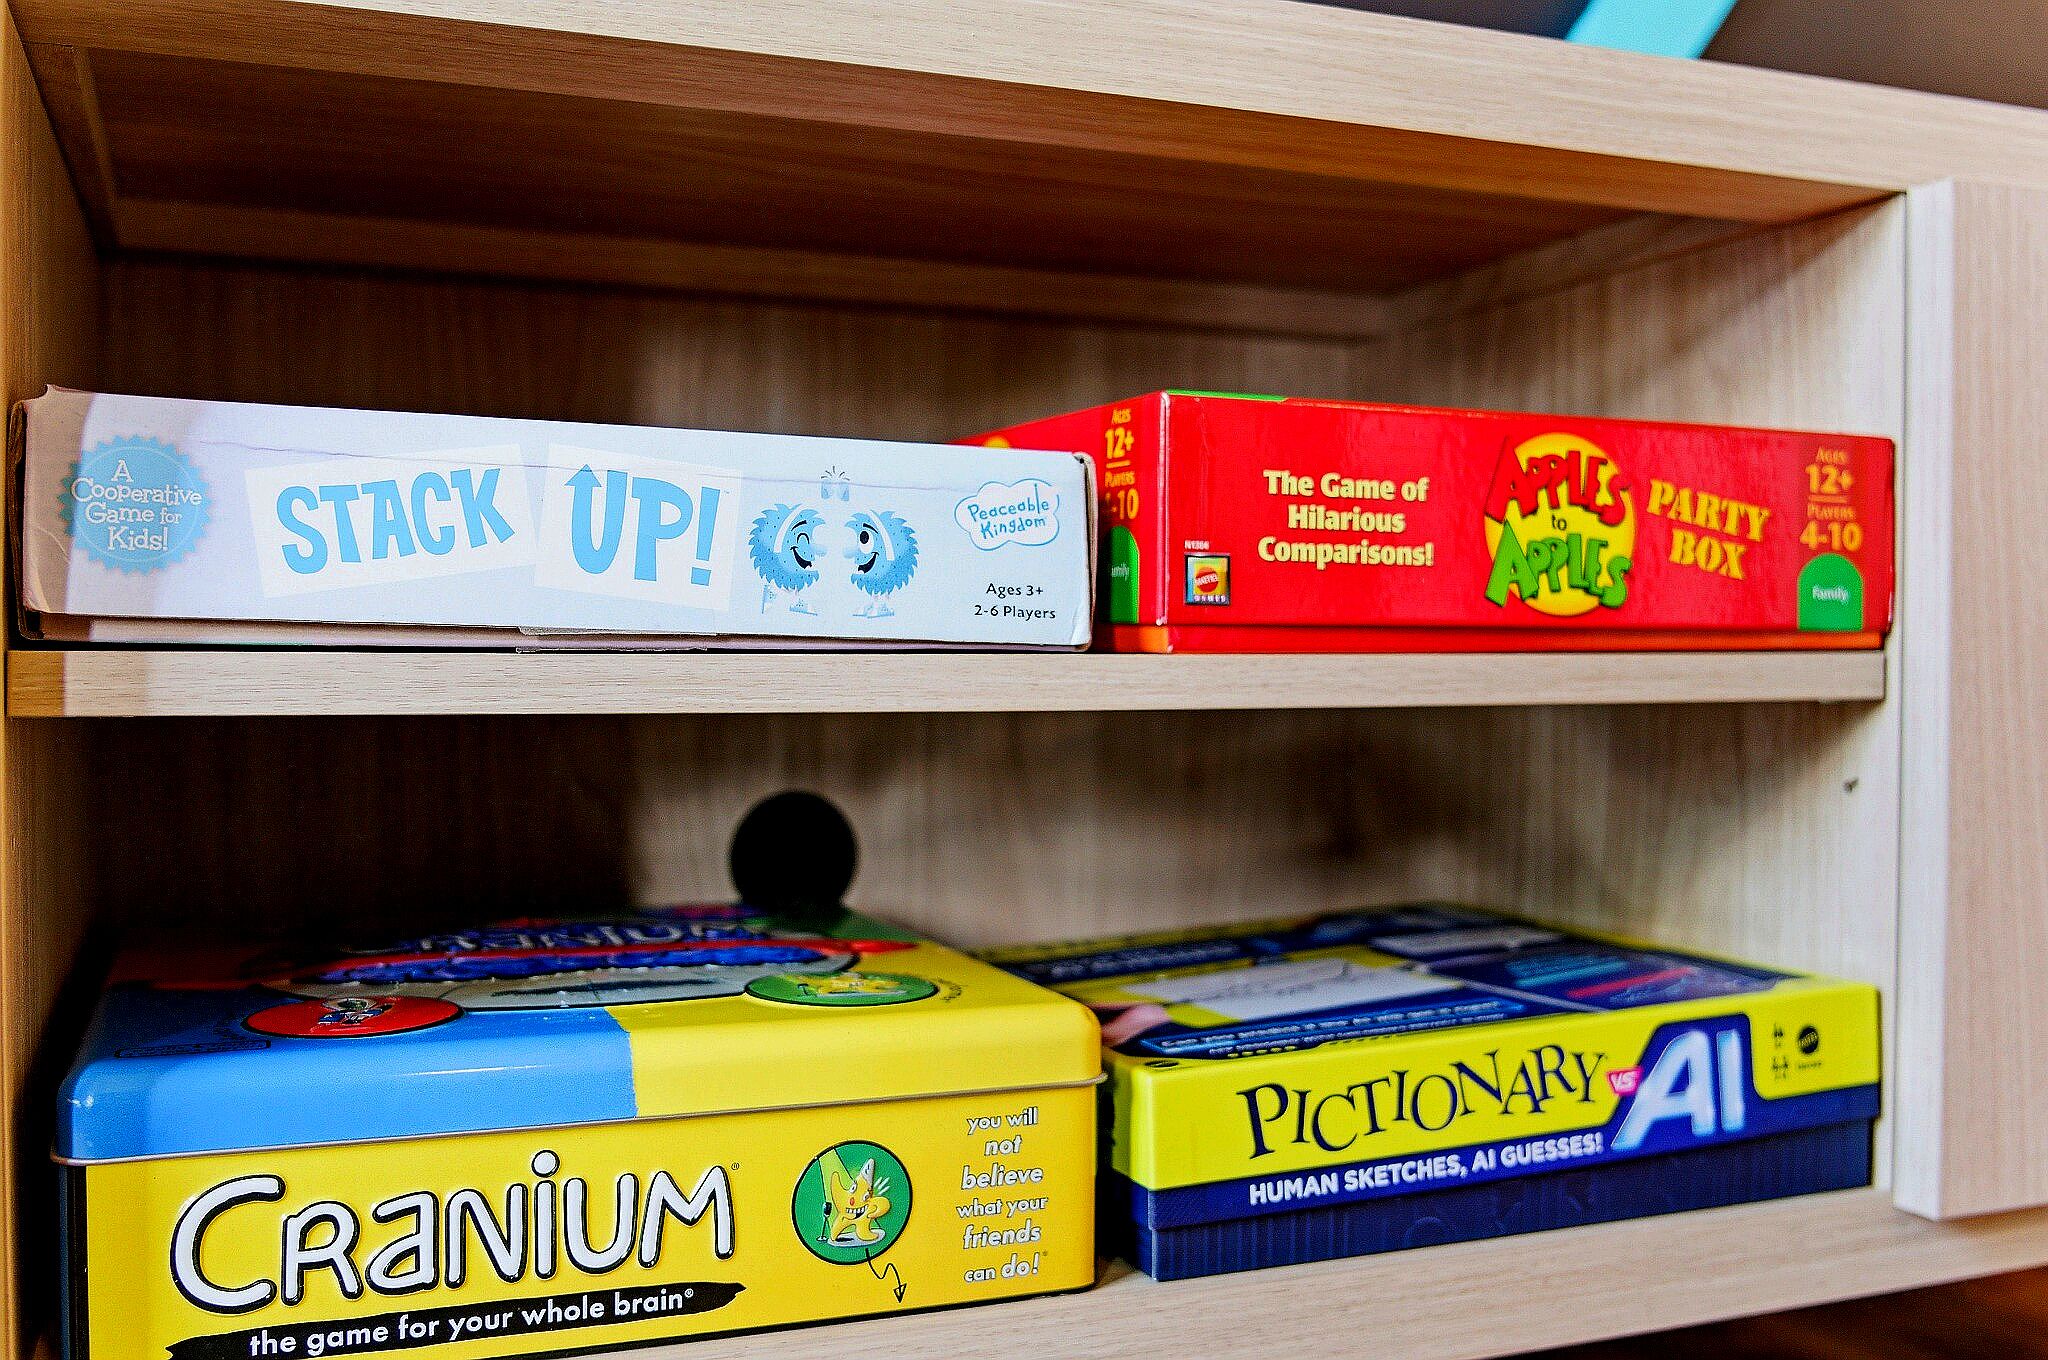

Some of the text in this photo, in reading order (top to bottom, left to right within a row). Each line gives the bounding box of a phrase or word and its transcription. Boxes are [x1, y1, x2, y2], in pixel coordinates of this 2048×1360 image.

[1105, 426, 1135, 460] 12+
[111, 459, 134, 483] A
[1262, 469, 1430, 502] The Game of
[1484, 436, 1633, 526] APPLES
[1804, 464, 1854, 495] 12+
[71, 477, 203, 506] Cooperative
[967, 483, 1050, 522] Peaceable
[85, 501, 183, 524] Game for
[276, 463, 721, 587] STACK UP!
[1287, 504, 1406, 533] Hilarious
[1550, 513, 1568, 532] to
[1645, 478, 1771, 544] PARTY
[108, 525, 169, 551] Kids!
[980, 517, 1046, 540] Kingdom
[1799, 520, 1864, 552] 4-10
[1257, 535, 1435, 570] Comparisons!
[1484, 518, 1633, 609] APPLES
[1668, 526, 1747, 580] BOX
[986, 583, 1044, 599] Ages 3+
[1812, 584, 1849, 604] Family
[974, 604, 1056, 621] 2-6 Players
[1236, 1044, 1607, 1160] PICTIONARY
[1611, 1029, 1746, 1151] AI
[967, 1107, 1038, 1135] you will
[984, 1135, 1022, 1157] not
[961, 1163, 1043, 1190] believe
[1249, 1132, 1605, 1206] HUMAN SKETCHES, AI GUESSES!
[956, 1197, 1049, 1219] what your
[963, 1218, 1041, 1249] friends
[963, 1252, 1040, 1284] can do!
[250, 1329, 297, 1356] the
[306, 1325, 390, 1356] game
[397, 1313, 440, 1340] for
[447, 1310, 513, 1341] your
[522, 1296, 605, 1325] whole
